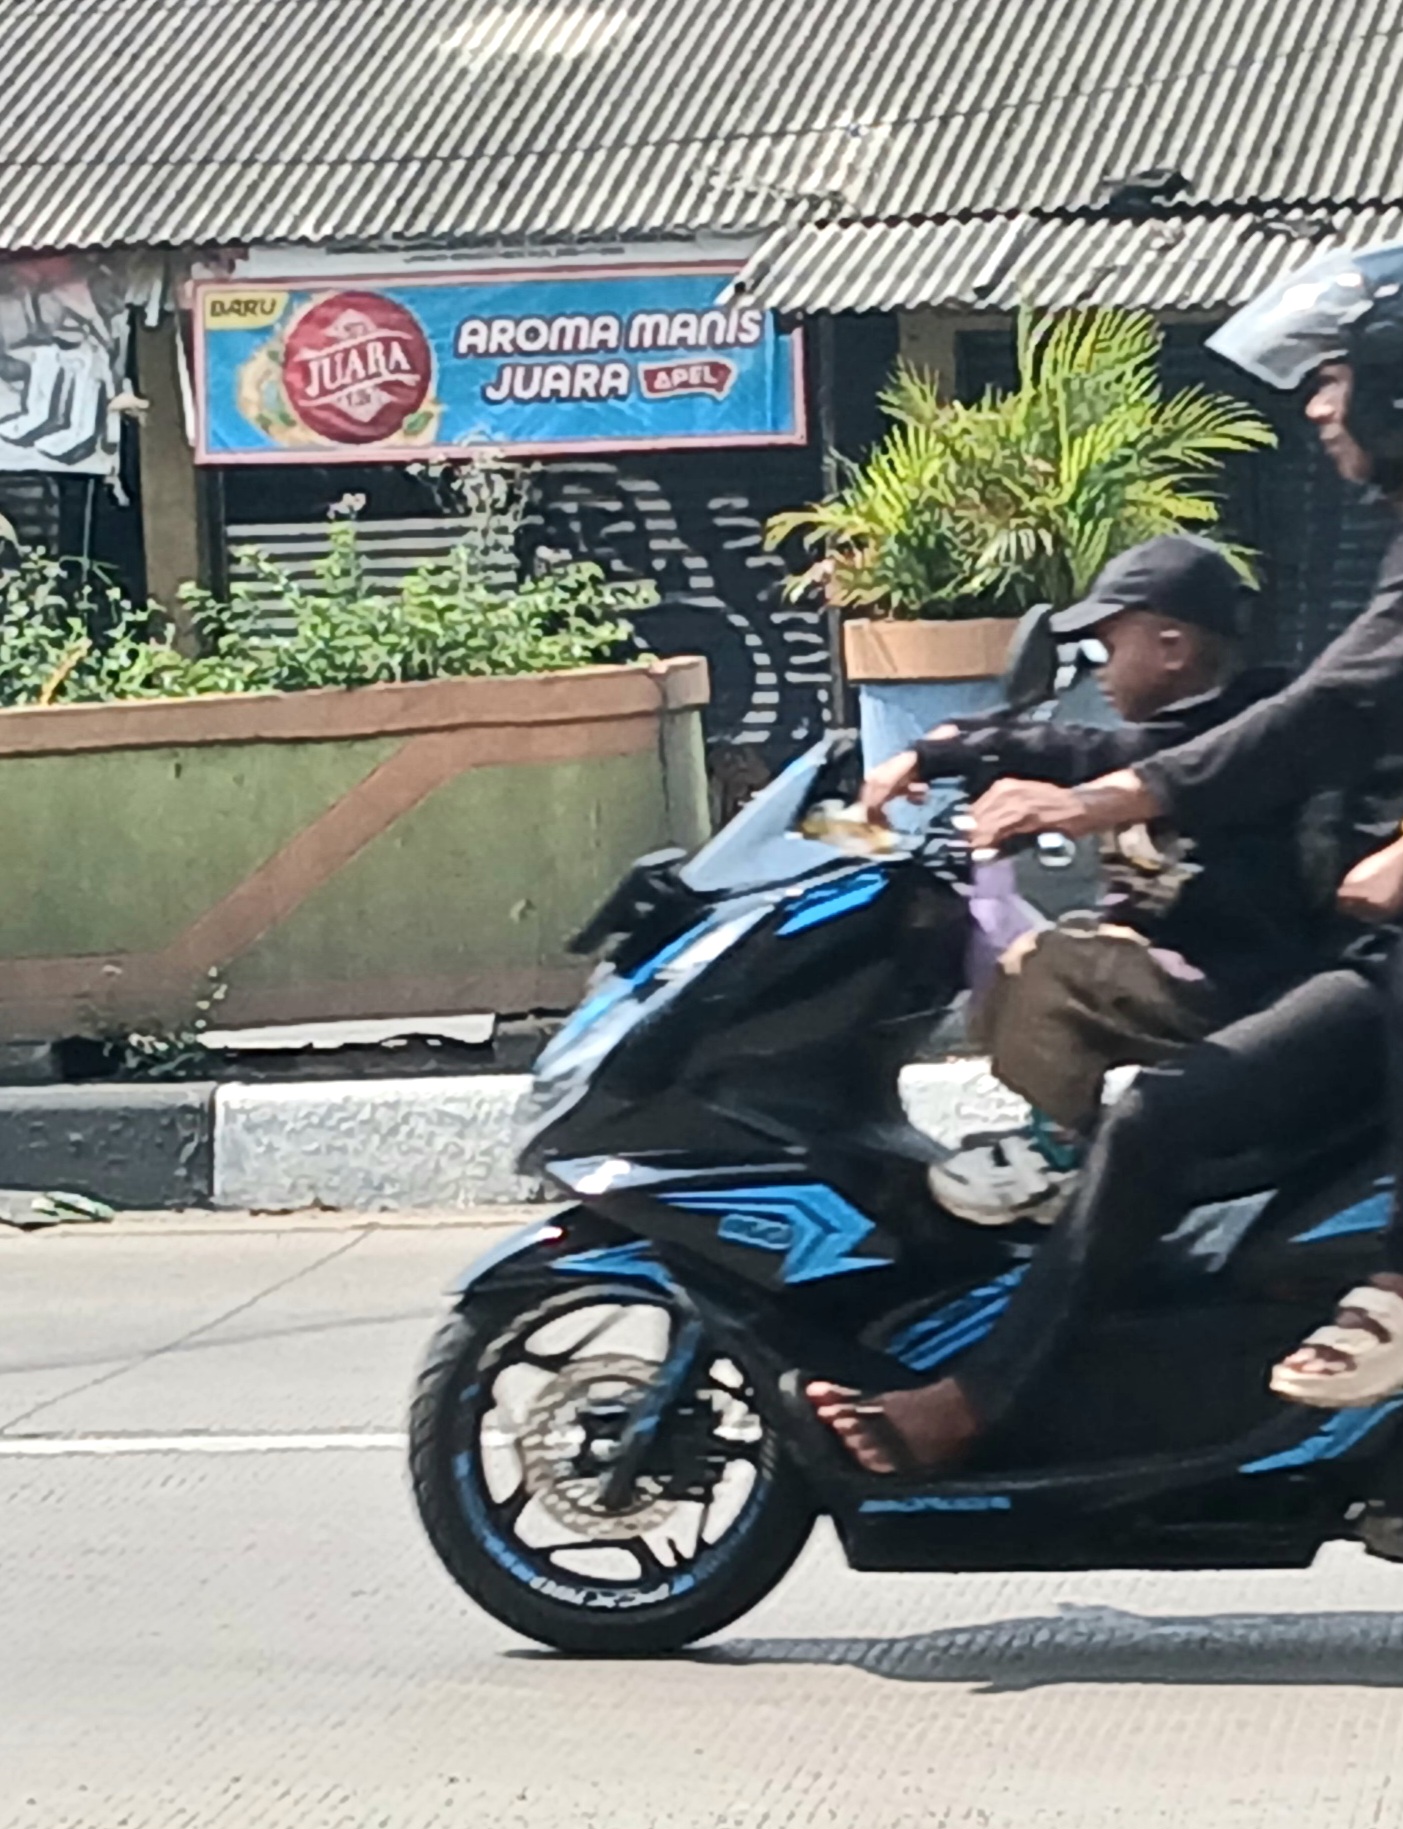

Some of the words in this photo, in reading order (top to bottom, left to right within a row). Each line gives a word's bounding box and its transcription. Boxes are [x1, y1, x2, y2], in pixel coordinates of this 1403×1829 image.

[210, 299, 277, 317] BARU
[456, 314, 621, 354] AROMA
[627, 310, 764, 348] MANIS
[305, 340, 411, 397] JUARA
[484, 363, 631, 401] JUARA
[653, 365, 719, 390] APEL
